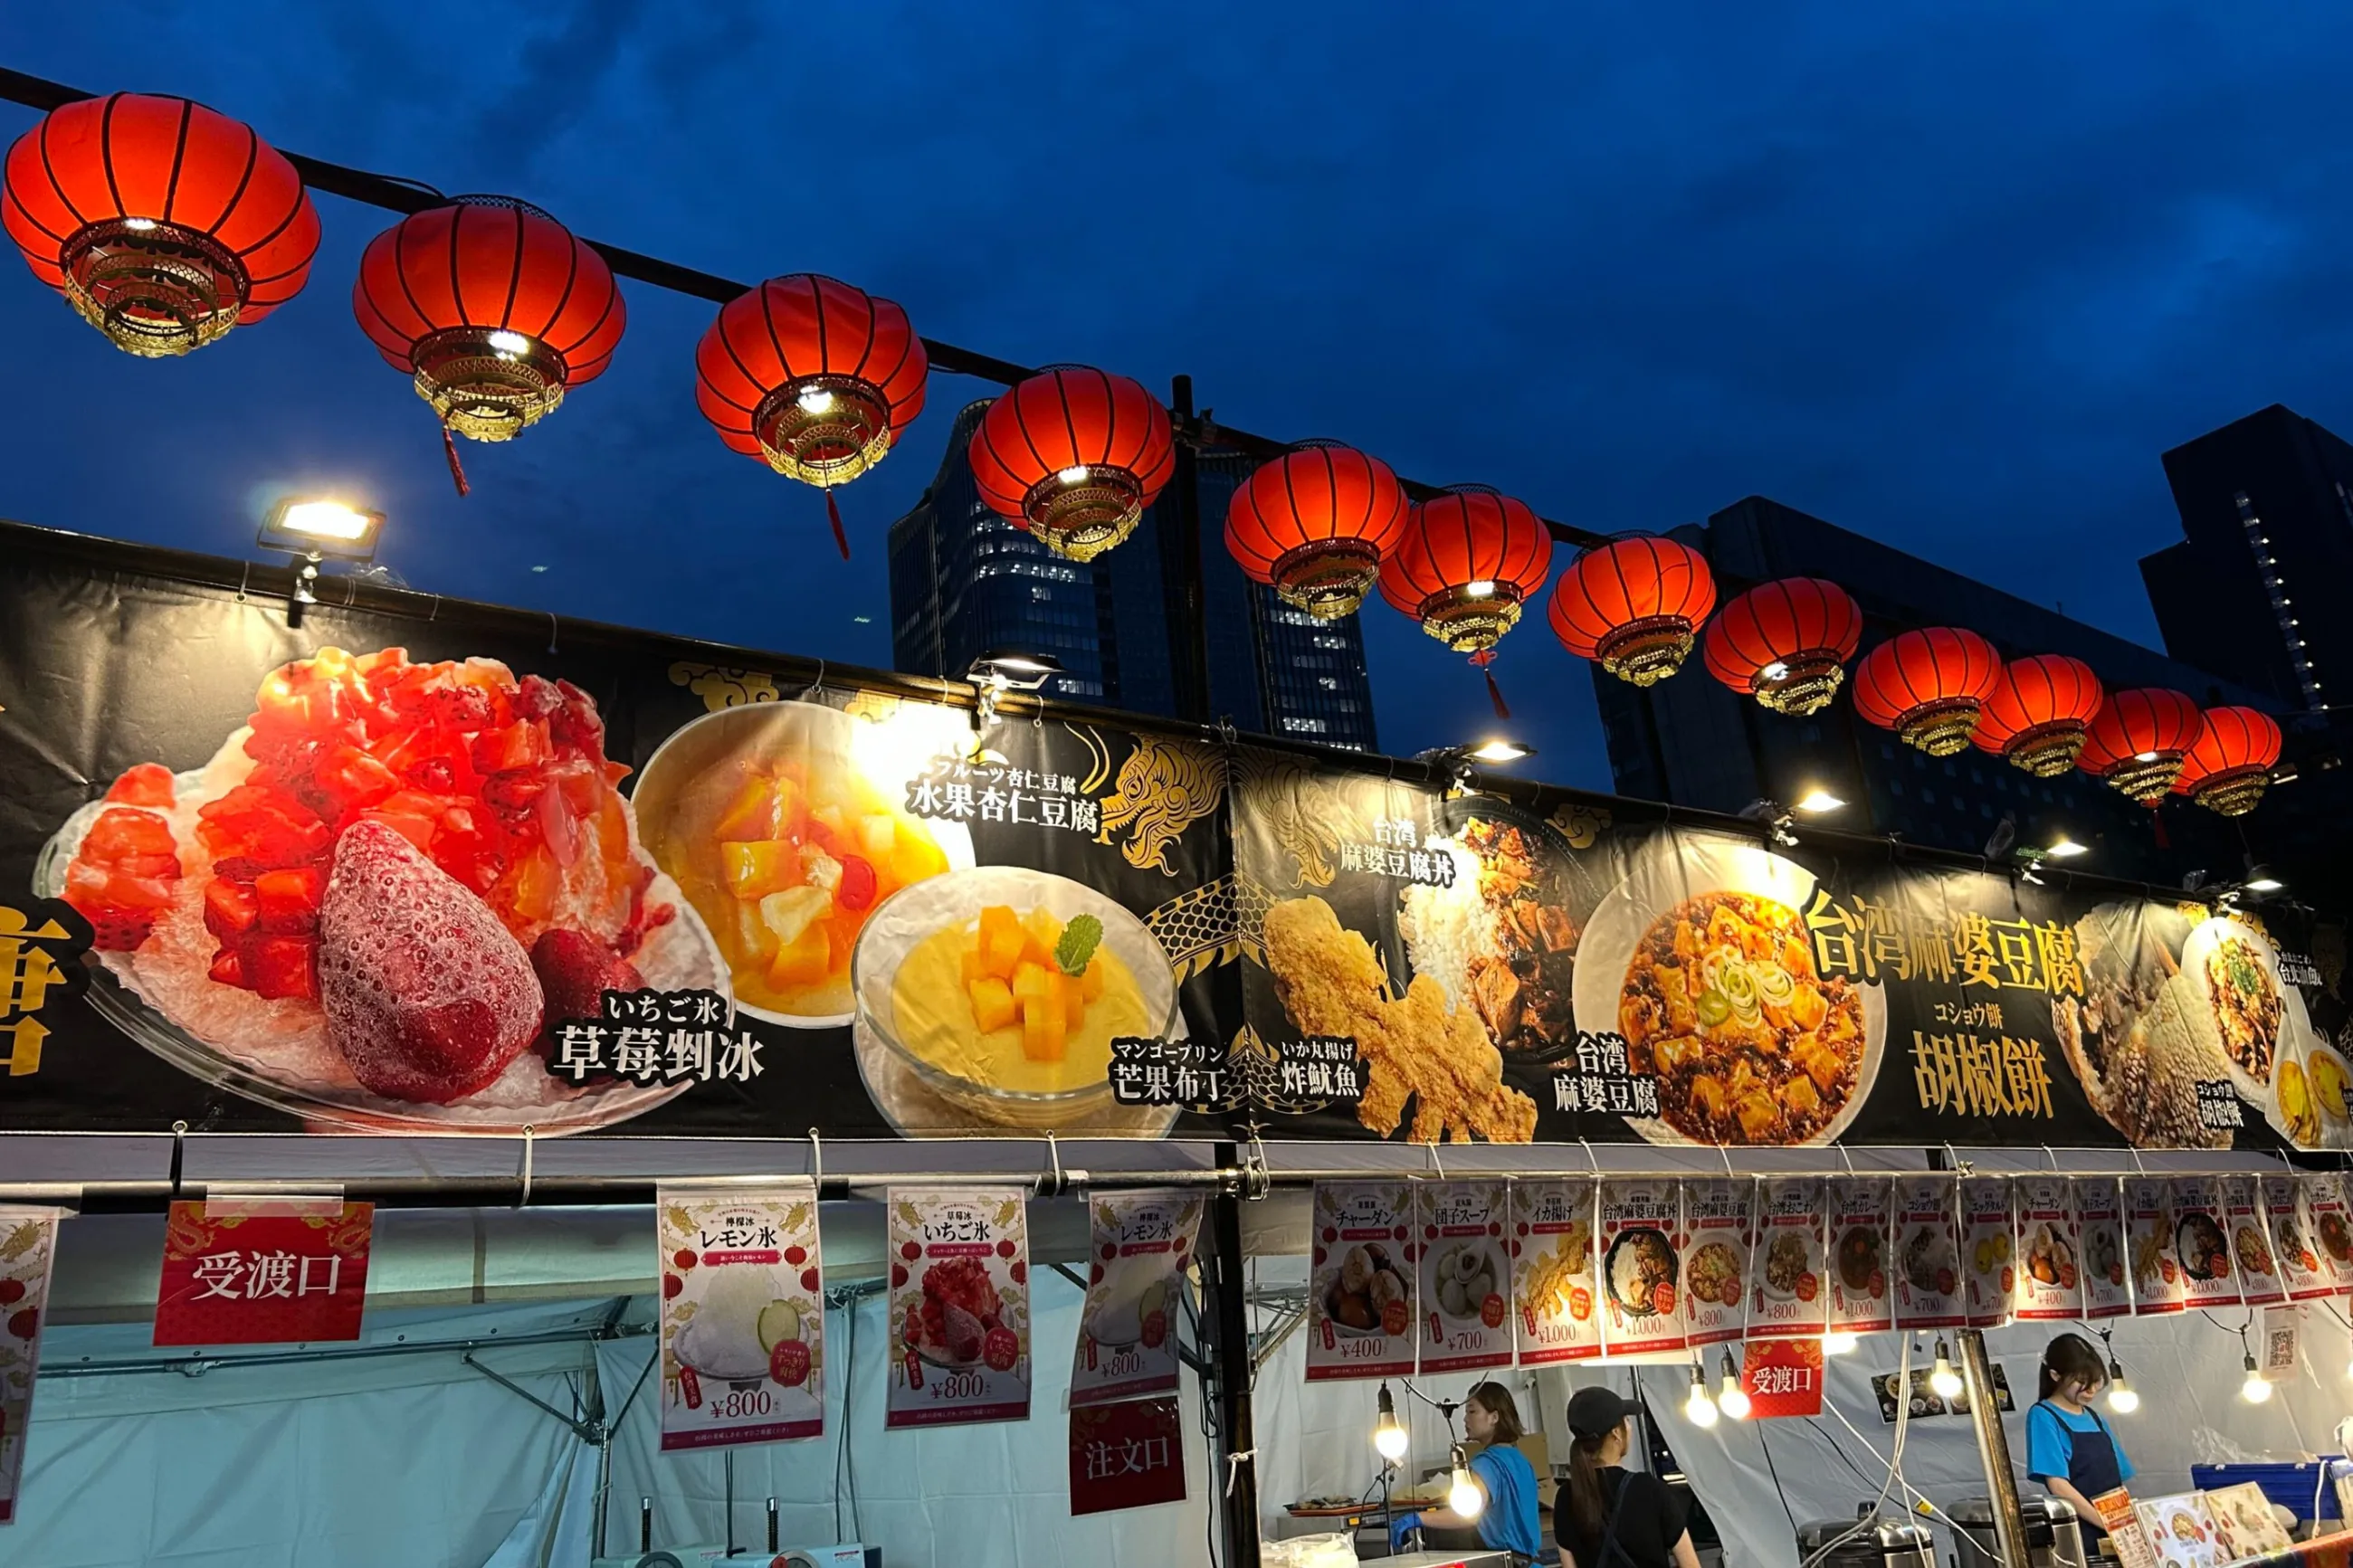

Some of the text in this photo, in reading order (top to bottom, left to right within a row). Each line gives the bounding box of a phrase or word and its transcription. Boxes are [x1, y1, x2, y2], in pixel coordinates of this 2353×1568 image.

[935, 760, 1077, 796] フルーツ杏仁豆腐
[910, 777, 1099, 834] 水果杏仁豆腐
[1373, 817, 1417, 848] 台湾
[1340, 841, 1453, 886] 麻婆豆腐丼
[1806, 889, 2085, 997] 台湾麻婆豆腐
[608, 995, 720, 1025] いちご氷
[1934, 1001, 2004, 1031] コショウ餅
[553, 1024, 766, 1082] 草莓剉冰
[1115, 1043, 1224, 1064] マンゴープリン
[1281, 1041, 1355, 1060] いか丸揚げ
[1575, 1035, 1628, 1075] 台湾
[1113, 1062, 1227, 1103] 芒果布丁
[1281, 1060, 1360, 1098] 炸魷魚
[1908, 1030, 2054, 1119] 胡椒餅
[1553, 1072, 1658, 1116] 麻婆豆腐
[2199, 1098, 2244, 1127] 胡椒餅
[1336, 1209, 1395, 1228] チャーダン
[1435, 1204, 1491, 1225] 団子スープ
[1532, 1204, 1574, 1222] イカ揚げ
[1604, 1202, 1678, 1220] 台湾麻婆豆腐丼
[1767, 1200, 1814, 1216] 台湾おこわ
[700, 1226, 778, 1249] レモン氷
[923, 1221, 991, 1242] いちご氷
[1120, 1221, 1173, 1242] レモン氷
[190, 1250, 342, 1301] 受渡口
[1767, 1303, 1797, 1320] ¥800
[1844, 1300, 1873, 1317] ¥1,000
[1914, 1297, 1940, 1312] ¥700
[1698, 1309, 1723, 1327] ¥800
[1448, 1330, 1482, 1350] ¥700
[1538, 1324, 1577, 1344] ¥1,000
[1340, 1338, 1382, 1358] ¥400
[1101, 1353, 1140, 1378] ¥800
[930, 1374, 984, 1399] ¥800
[1751, 1365, 1812, 1396] 受渡口
[710, 1391, 772, 1419] ¥800
[1086, 1436, 1168, 1480] 注文口
